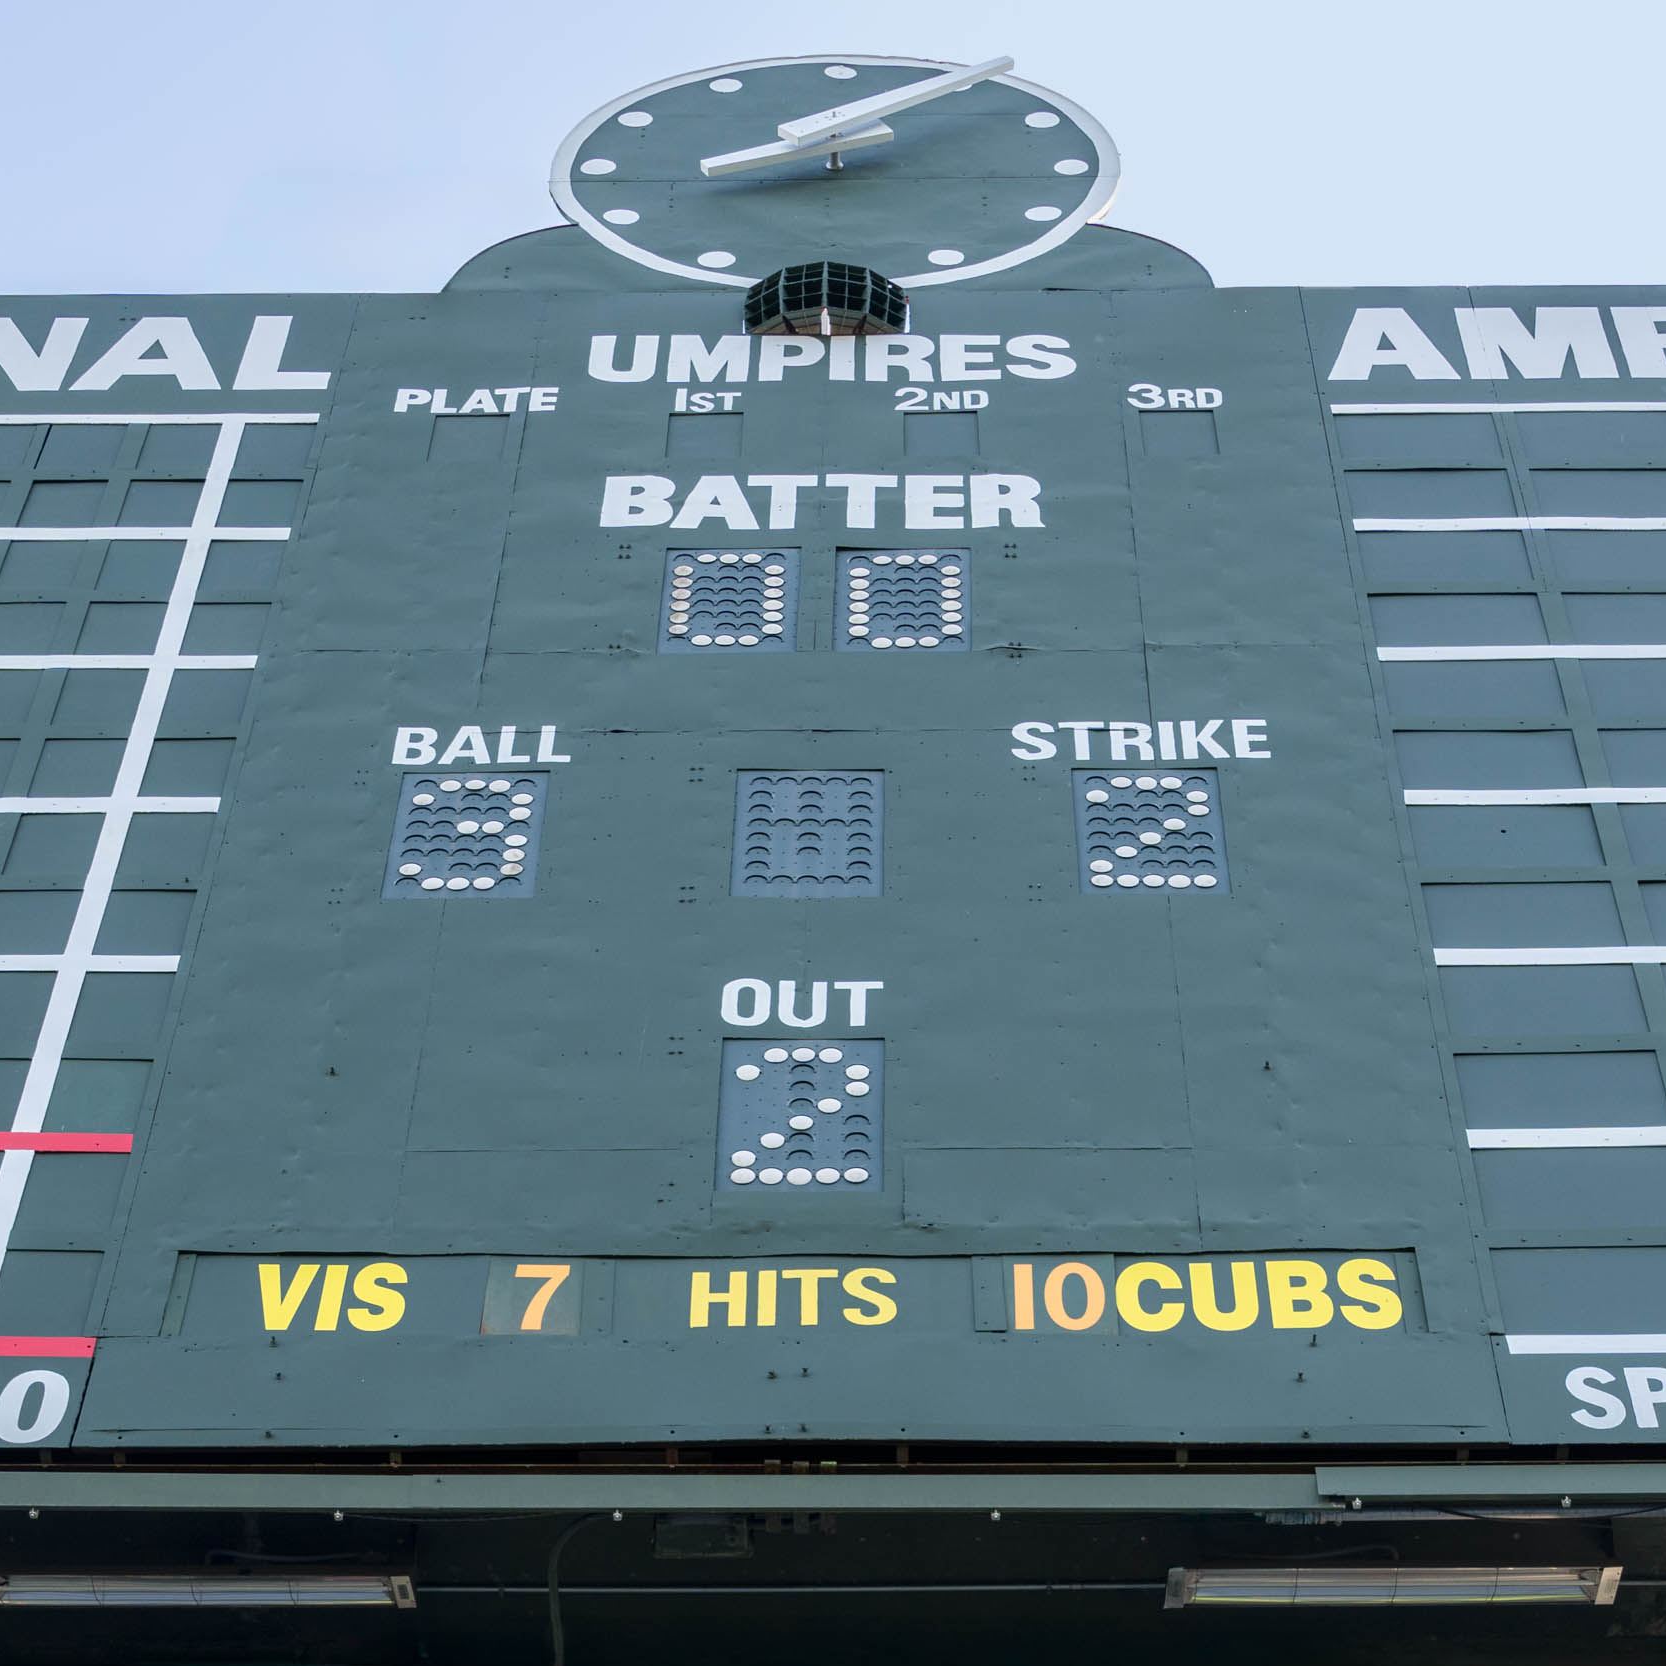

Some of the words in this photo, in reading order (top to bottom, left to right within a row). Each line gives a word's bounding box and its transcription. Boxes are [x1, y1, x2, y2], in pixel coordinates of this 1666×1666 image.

[588, 335, 1077, 382] UMPIRES
[394, 387, 559, 413] PLATE
[675, 388, 741, 412] 1ST
[895, 387, 989, 410] 2ND
[1127, 384, 1222, 408] 3RD
[600, 474, 1045, 529] BATTER
[392, 725, 570, 765] BALL
[1012, 719, 1271, 760] STRIKE
[400, 780, 533, 889] 3
[1086, 777, 1217, 887] 2
[721, 978, 883, 1027] OUT
[731, 1048, 869, 1185] 2
[259, 1263, 407, 1331] VIS
[515, 1265, 570, 1330] 7
[690, 1269, 897, 1328] HITS
